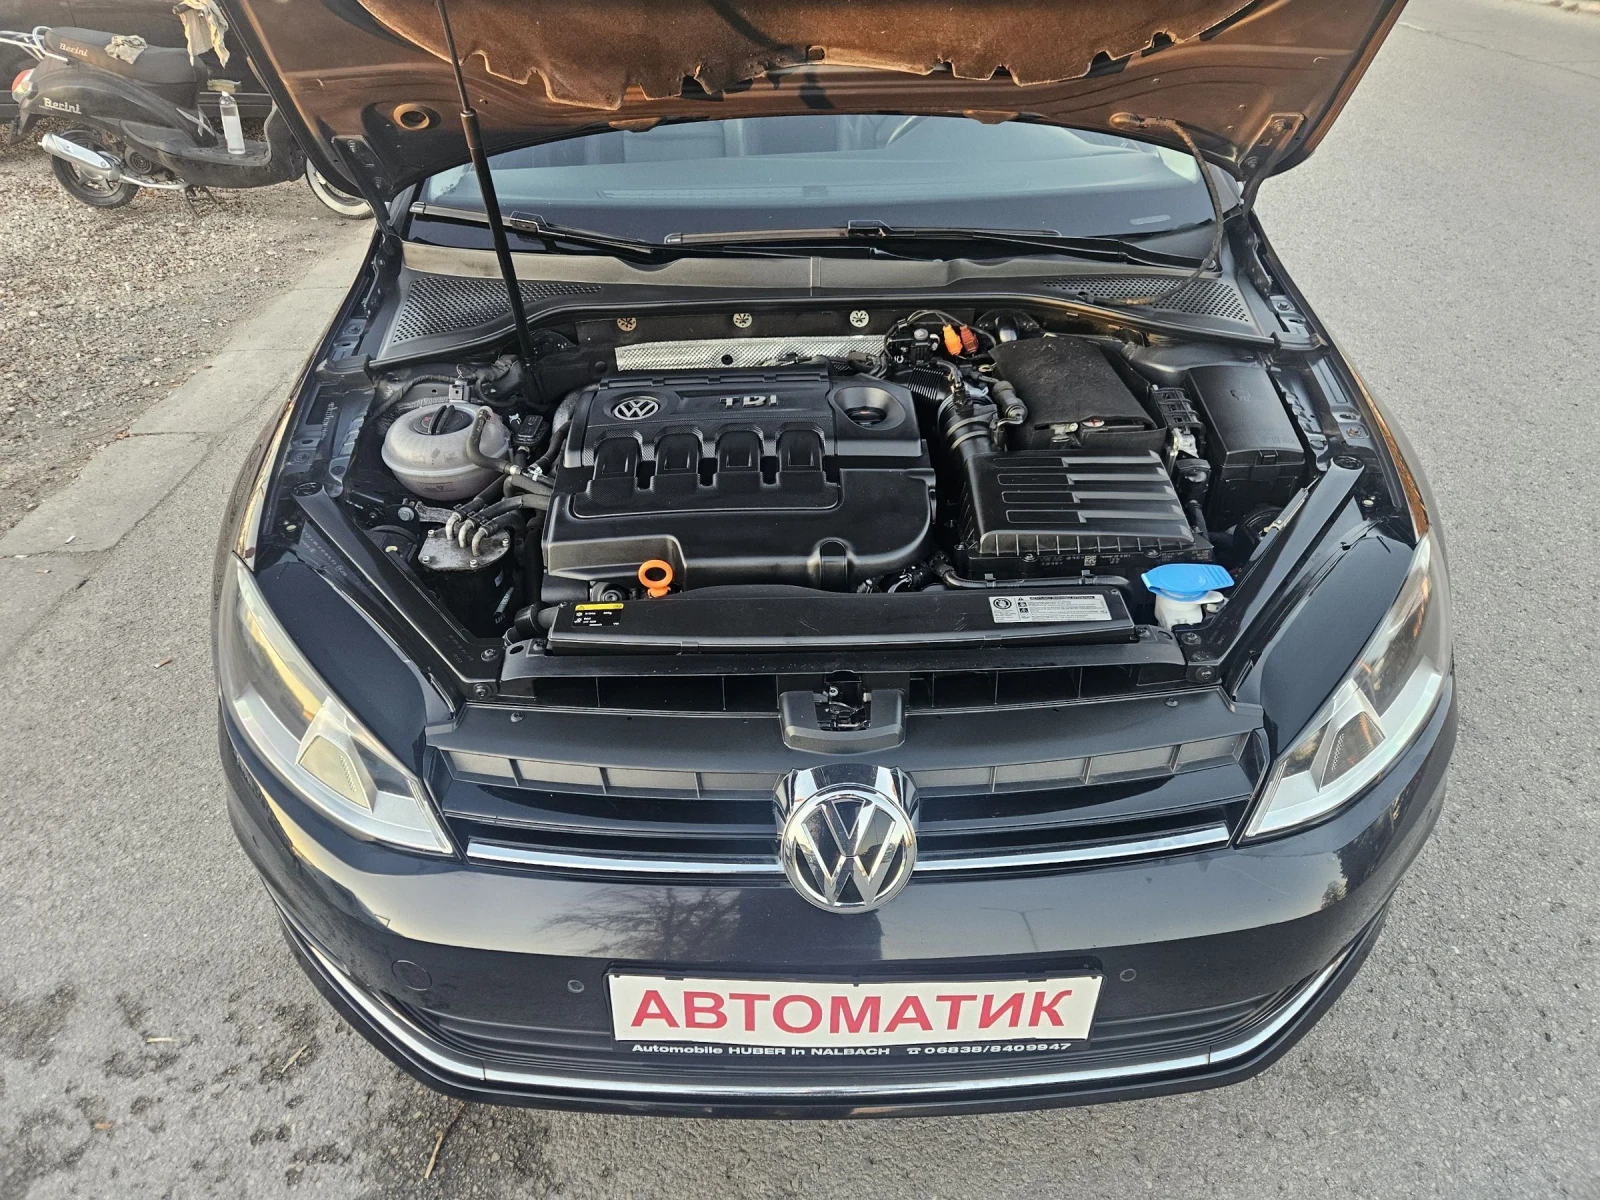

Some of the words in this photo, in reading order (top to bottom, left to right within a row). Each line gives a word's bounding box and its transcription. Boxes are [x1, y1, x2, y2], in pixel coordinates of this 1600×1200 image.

[59, 43, 88, 57] Berini
[43, 97, 82, 114] Berini
[615, 398, 659, 420] VW
[719, 395, 779, 409] TDI
[788, 790, 912, 910] VW
[631, 990, 1073, 1034] АВТОМАТИК
[631, 1044, 723, 1055] Automobile
[728, 1047, 786, 1056] HUBER
[791, 1047, 805, 1056] in
[810, 1047, 890, 1056] NALBACH
[924, 1043, 1072, 1055] 06838/8409947
